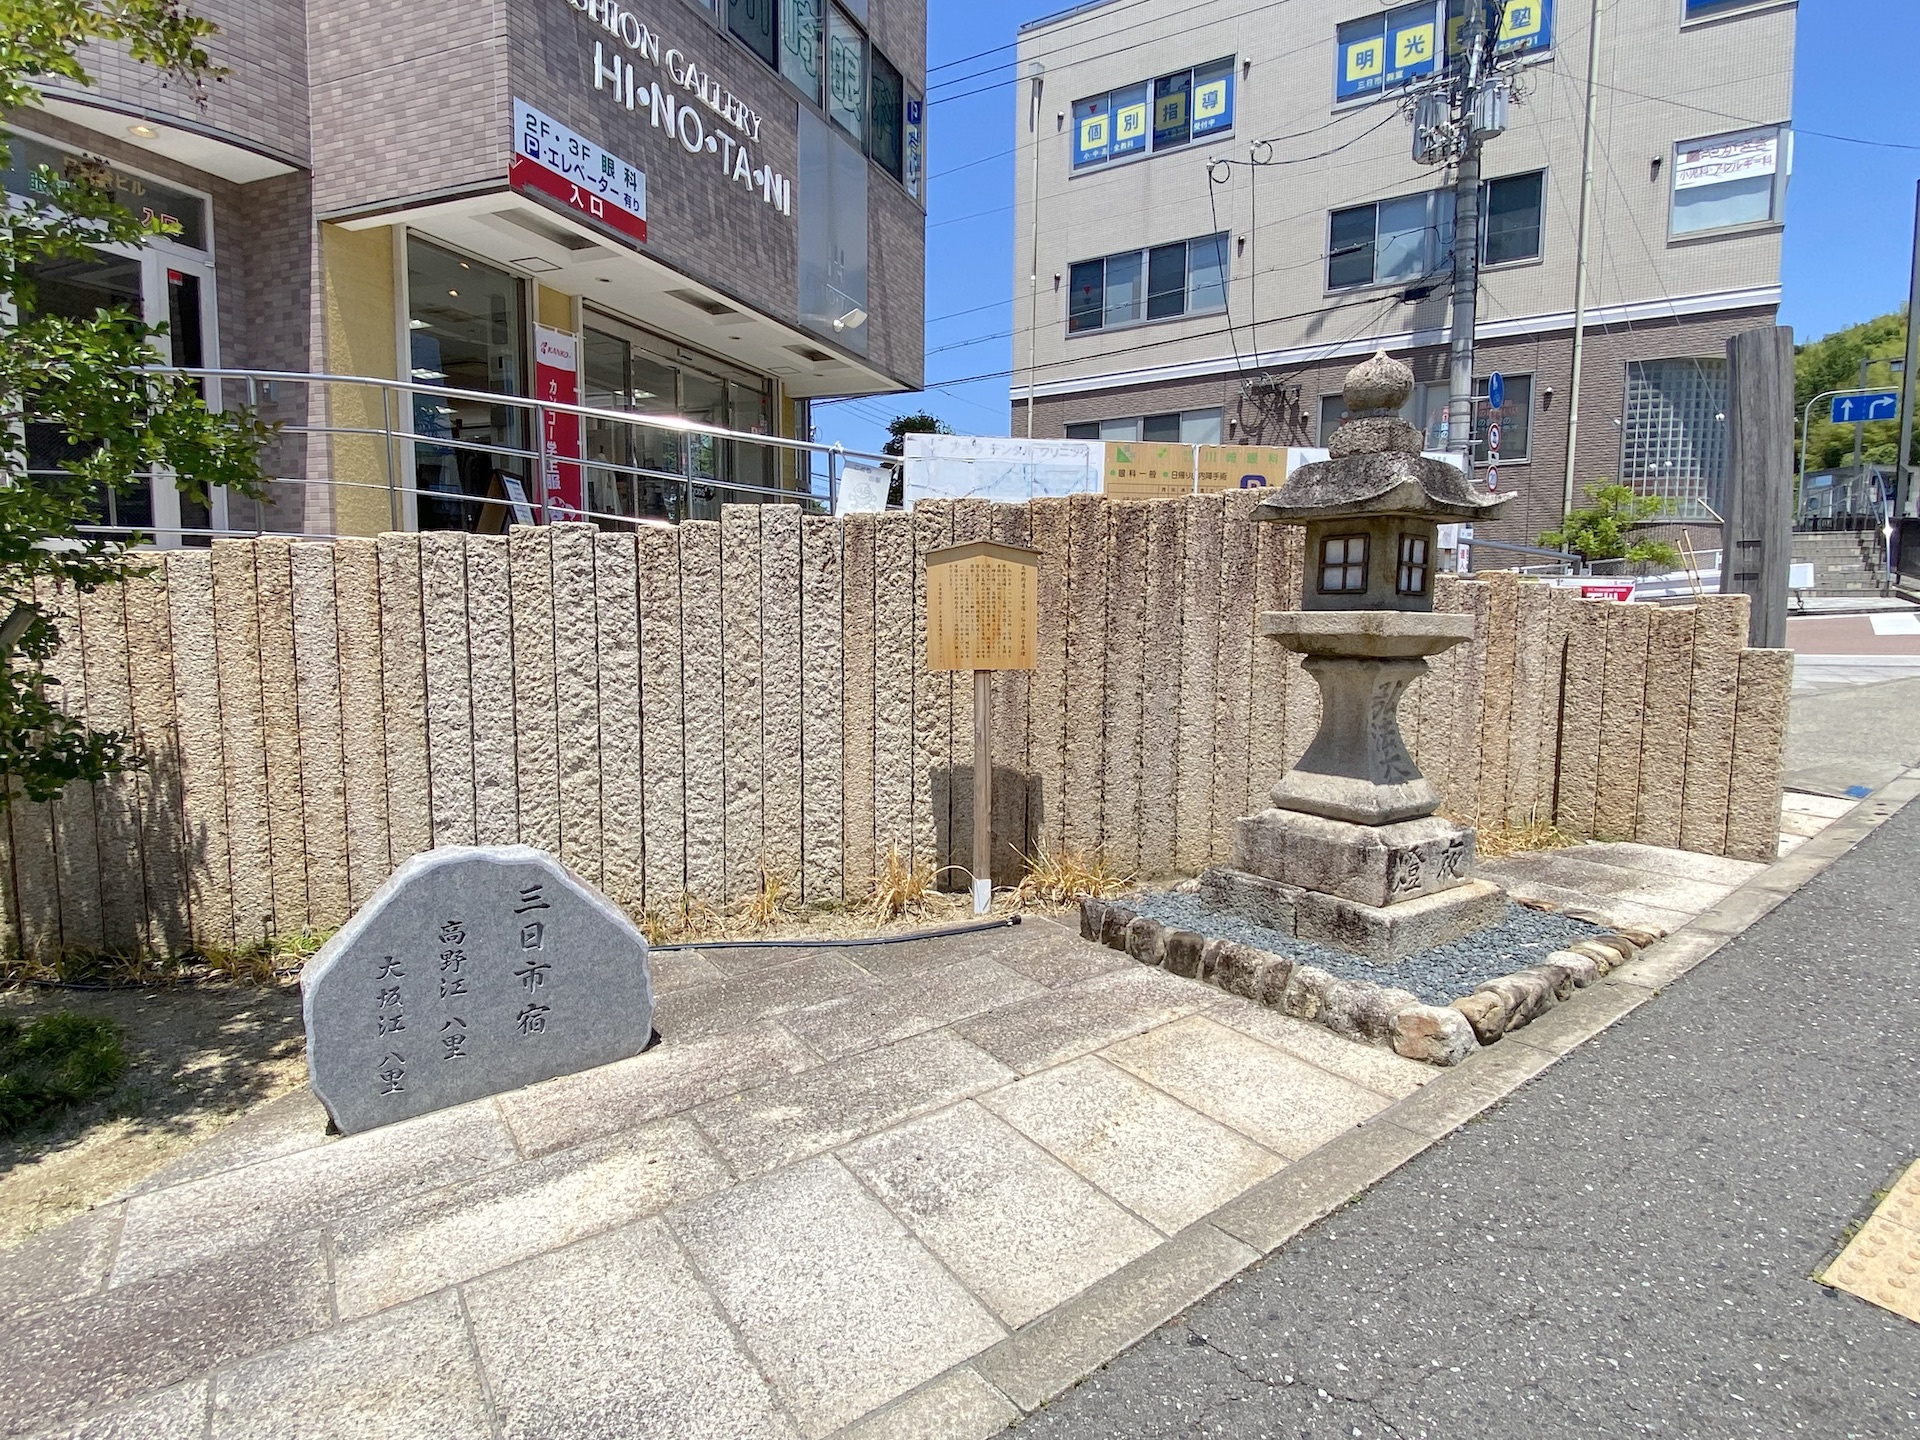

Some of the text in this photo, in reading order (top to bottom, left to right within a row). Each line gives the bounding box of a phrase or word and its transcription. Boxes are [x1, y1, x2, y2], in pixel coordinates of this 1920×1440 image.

[665, 49, 762, 143] GALLERY
[1087, 89, 1219, 143] 個別指導
[601, 153, 637, 192] 眼科
[570, 184, 605, 219] 入口
[513, 884, 552, 1036] 三日市宿
